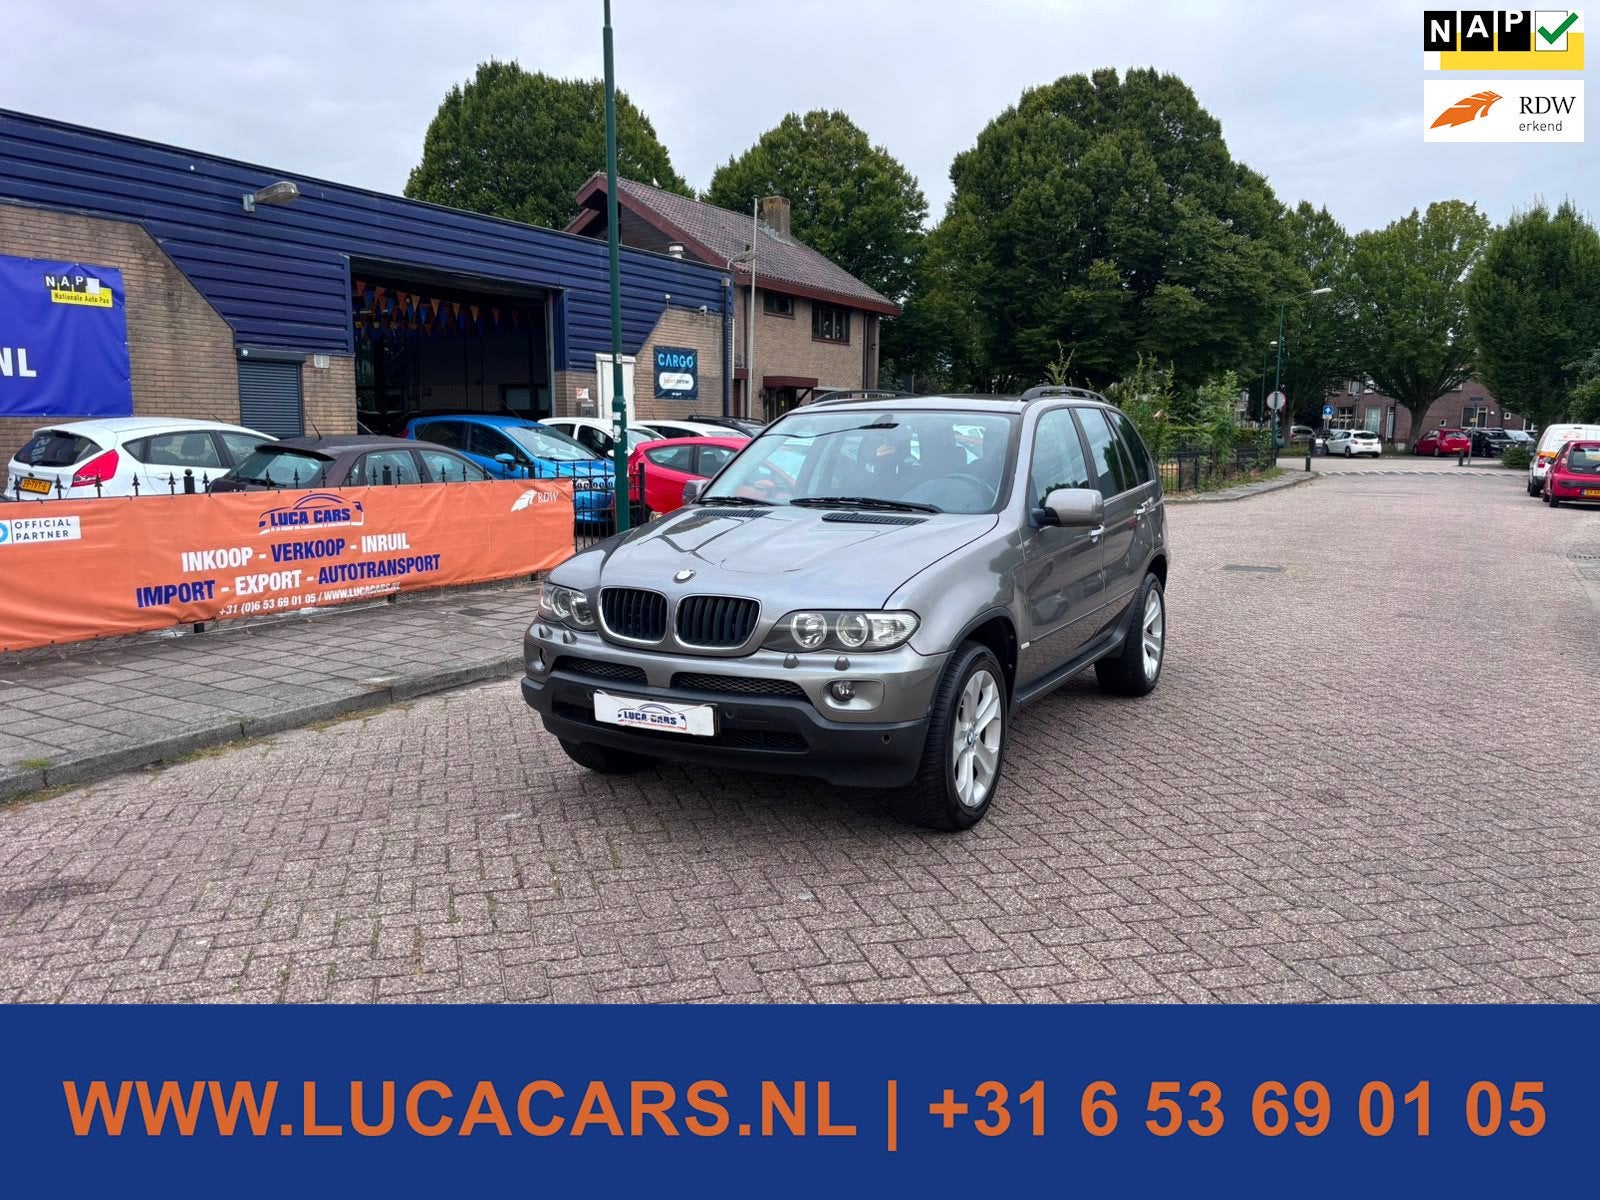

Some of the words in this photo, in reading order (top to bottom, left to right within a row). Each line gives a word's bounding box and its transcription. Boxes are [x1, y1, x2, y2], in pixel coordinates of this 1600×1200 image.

[45, 275, 84, 287] NAP
[54, 292, 83, 302] Nationale
[84, 295, 98, 303] Auto
[99, 296, 110, 304] Pas
[658, 353, 694, 369] CARGO
[538, 491, 559, 503] RDW
[14, 518, 71, 530] OFFICIAL
[270, 511, 309, 527] LUCA
[313, 508, 351, 524] CARS
[15, 530, 69, 541] PARTNER
[181, 547, 253, 573] INKOOP
[270, 538, 346, 563] VERKOOP
[361, 532, 410, 554] INRUIL
[135, 580, 215, 608] IMPORT
[234, 569, 302, 596] EXPORT
[318, 553, 441, 585] AUTOTRANSPORT
[219, 603, 237, 616] +31
[240, 599, 260, 614] (0)6
[263, 598, 275, 610] 53
[277, 596, 289, 608] 69
[291, 595, 302, 606] 01
[305, 592, 316, 604] 05
[624, 711, 647, 722] LUCA
[649, 714, 677, 726] CARS
